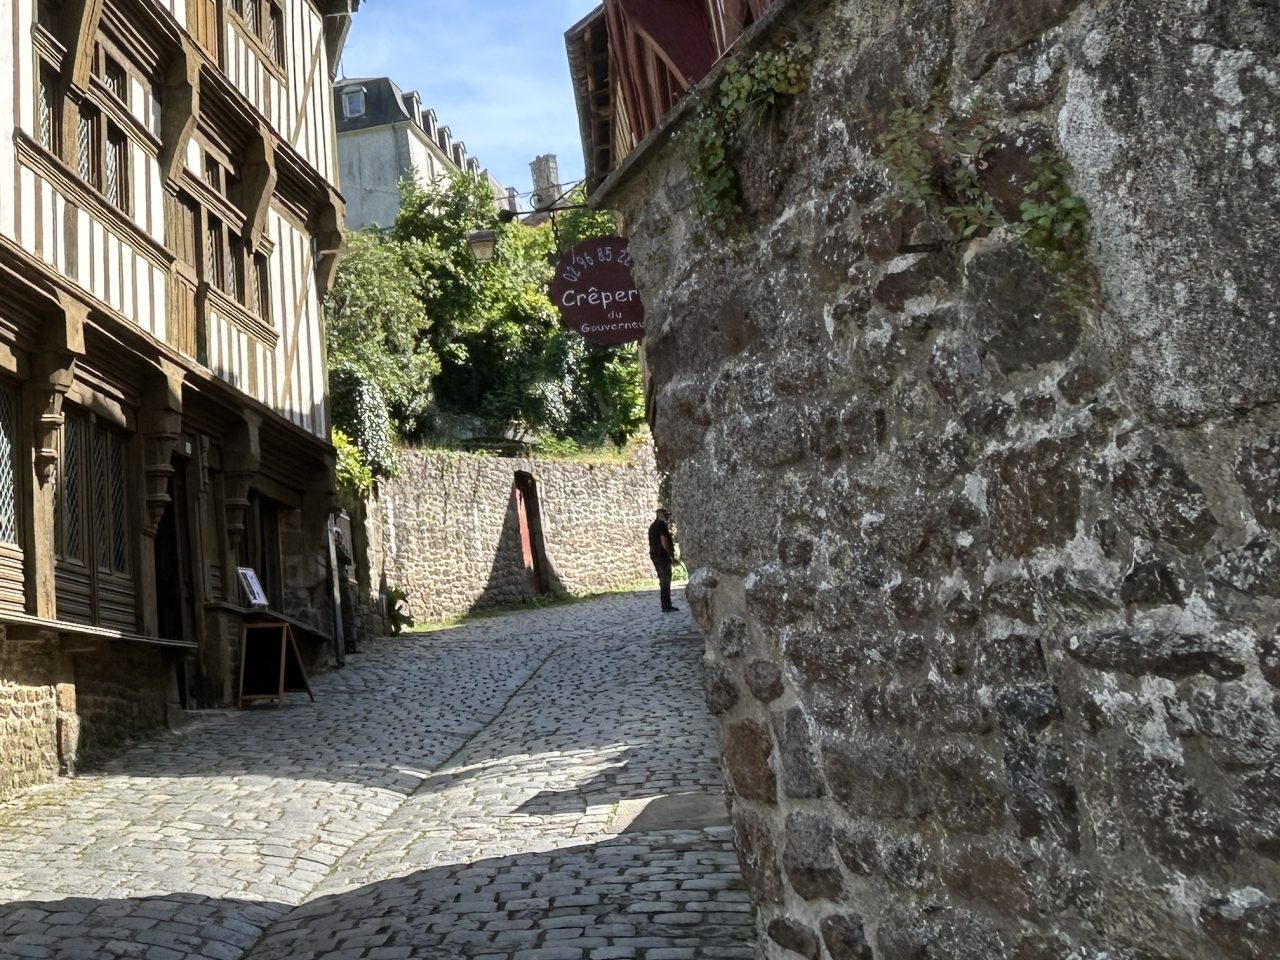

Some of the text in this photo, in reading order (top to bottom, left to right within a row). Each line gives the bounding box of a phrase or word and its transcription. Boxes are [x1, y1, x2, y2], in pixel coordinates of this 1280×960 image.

[597, 246, 613, 262] 85
[562, 287, 638, 309] Crêper
[607, 310, 622, 319] du
